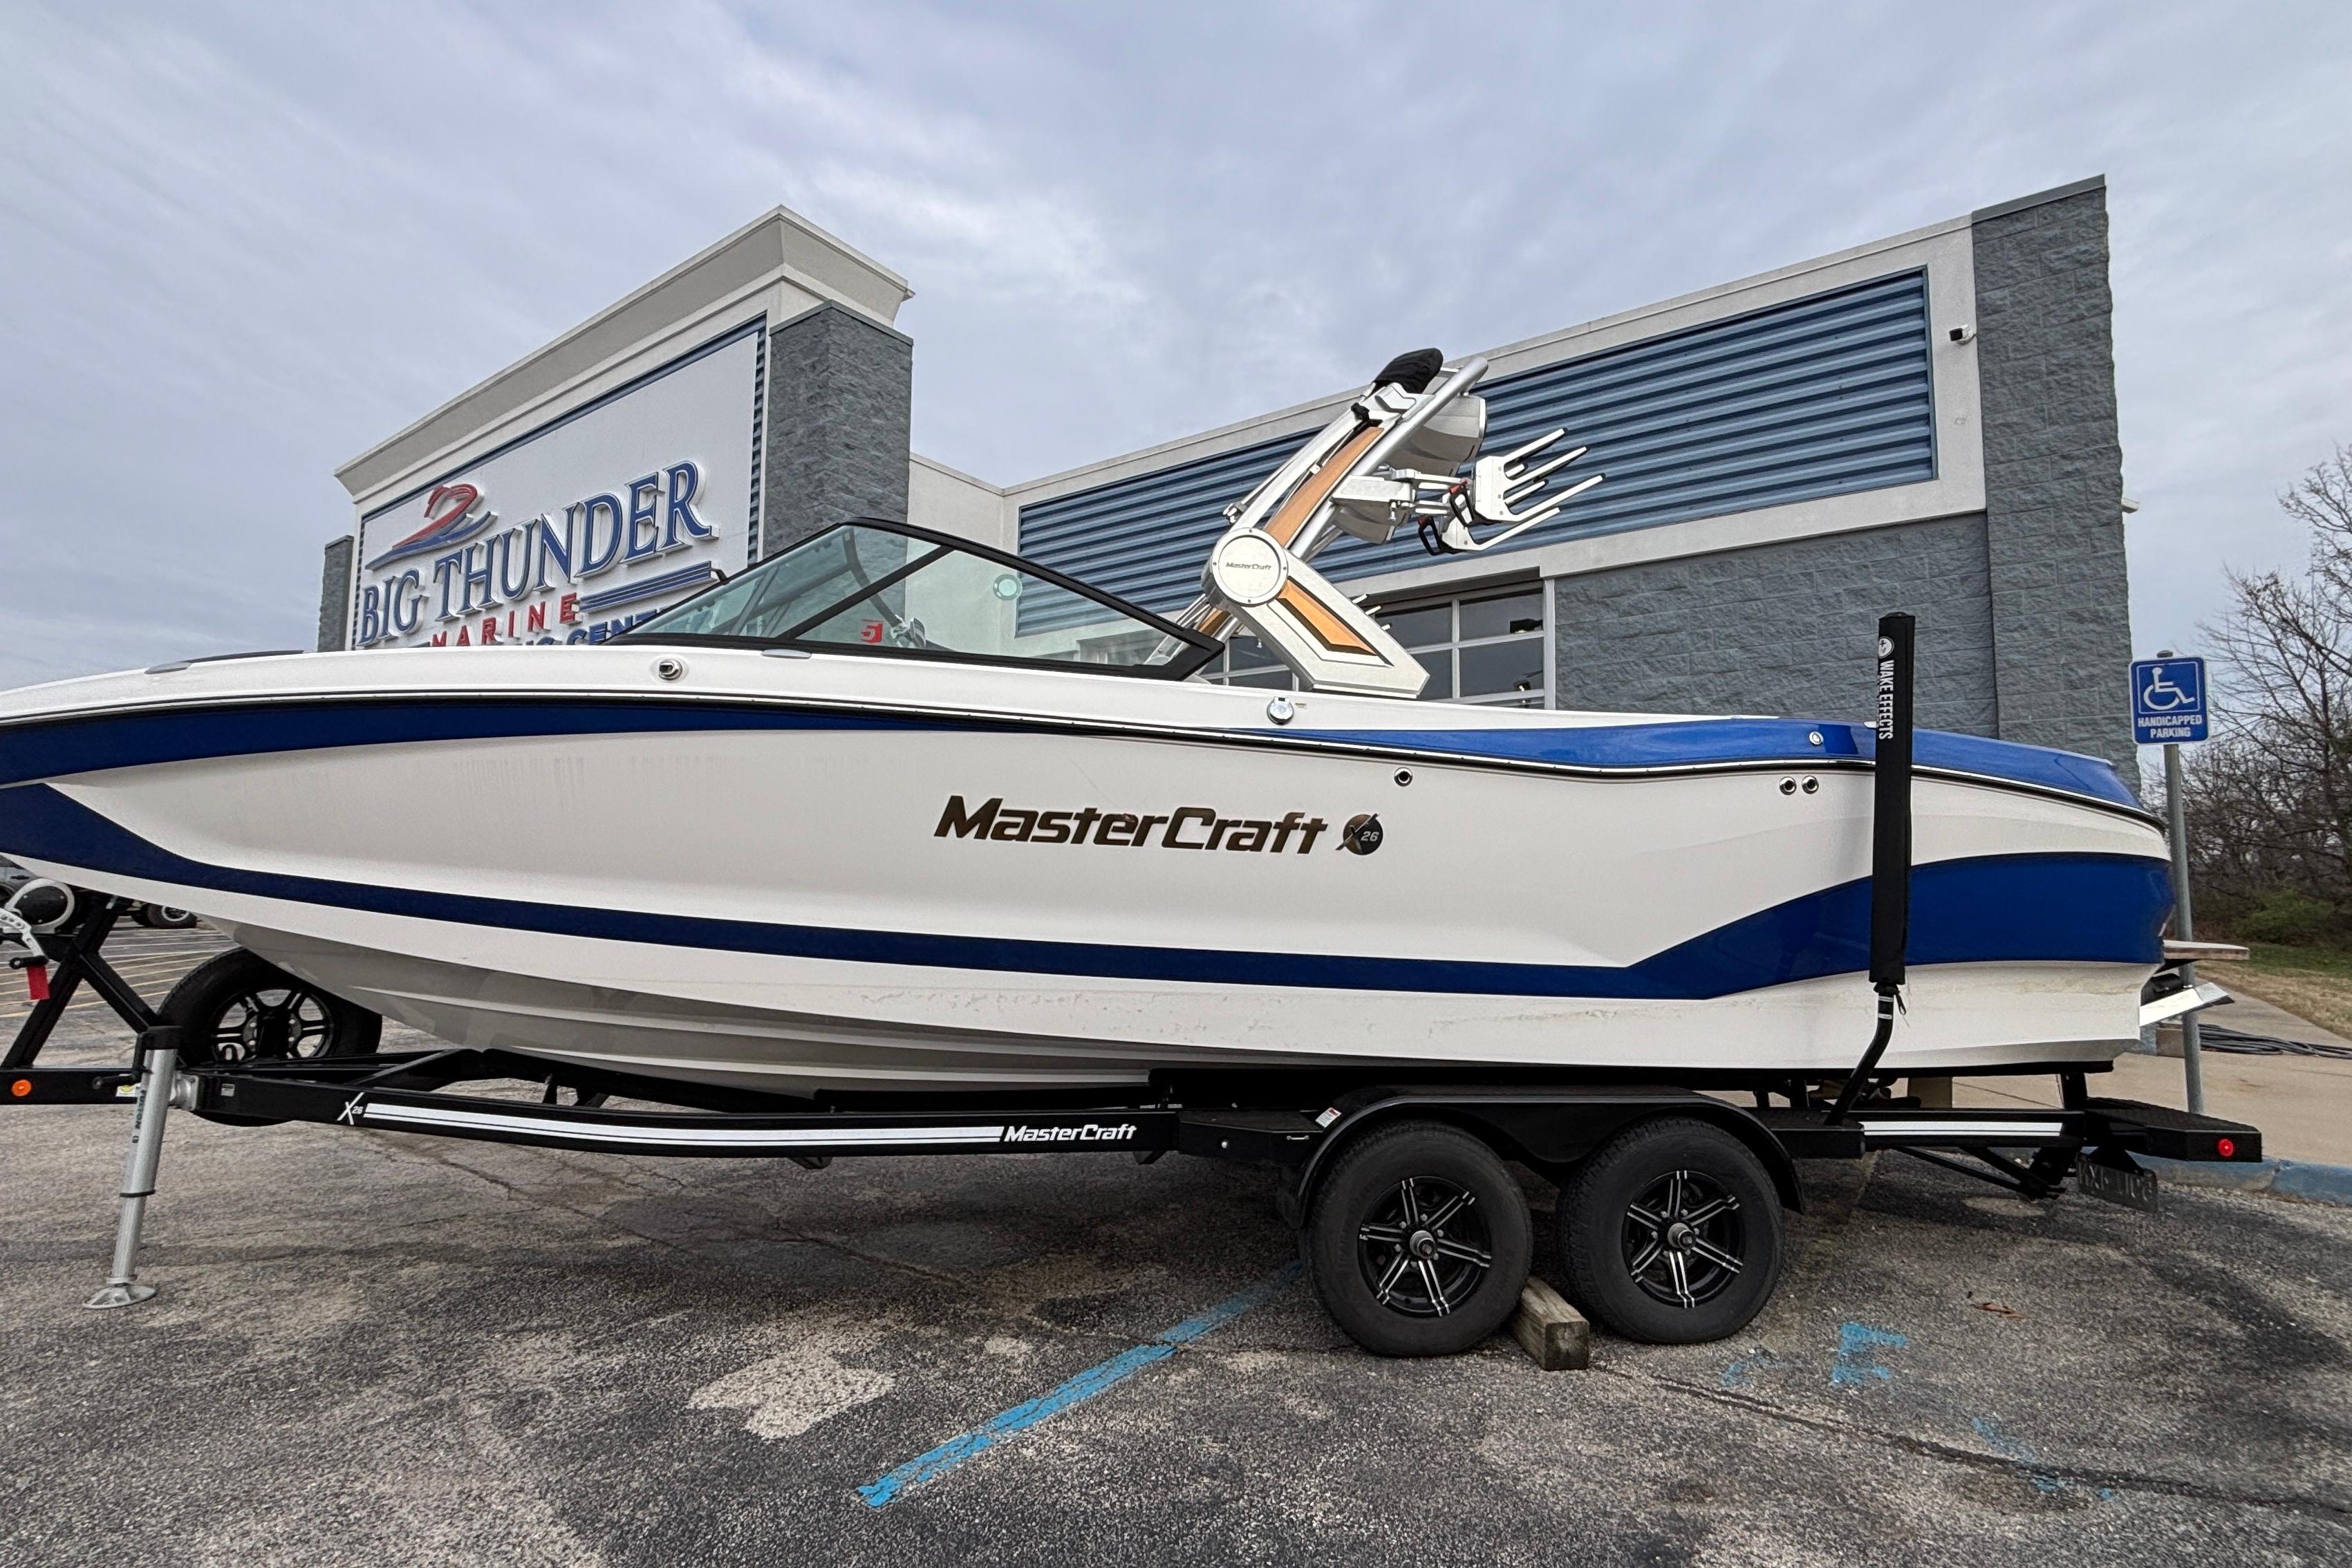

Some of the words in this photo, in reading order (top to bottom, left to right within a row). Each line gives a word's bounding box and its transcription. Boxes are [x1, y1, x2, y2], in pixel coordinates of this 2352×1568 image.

[357, 568, 426, 646] BIG
[433, 460, 714, 622] THUNDER
[1225, 561, 1272, 570] MasterCraft
[430, 592, 578, 646] MARINE
[1879, 660, 1894, 692] WAKE
[1878, 693, 1894, 740] EFFECTS
[2137, 714, 2203, 727] HANDICAPPED
[2149, 726, 2192, 738] PARKING
[933, 795, 1329, 855] MasterCraft
[1003, 1123, 1138, 1142] MasterCraft
